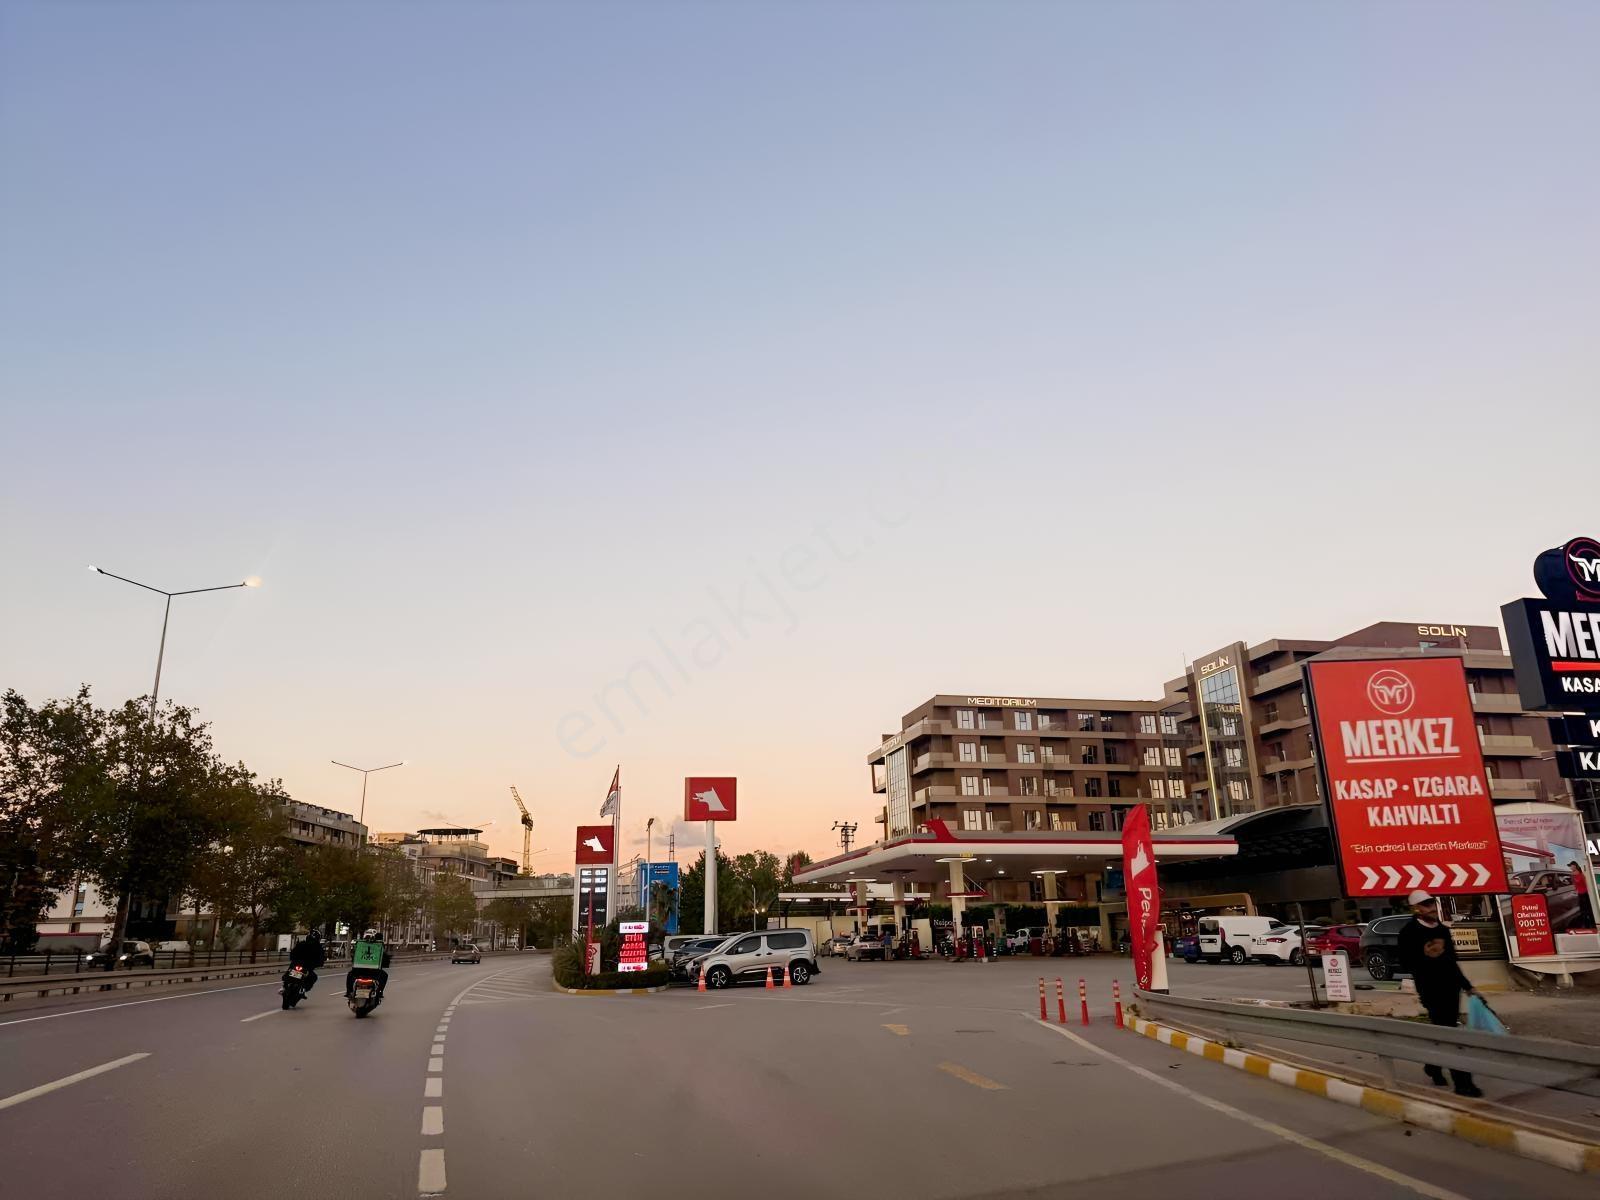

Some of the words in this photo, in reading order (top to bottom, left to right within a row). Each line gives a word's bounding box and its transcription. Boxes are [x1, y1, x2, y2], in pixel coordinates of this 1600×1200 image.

[1340, 717, 1460, 757] MERKEZ
[1335, 778, 1398, 801] KASAP
[1412, 775, 1484, 798] IZGARA
[1367, 803, 1461, 827] KAHVALTI
[1519, 919, 1535, 928] 900
